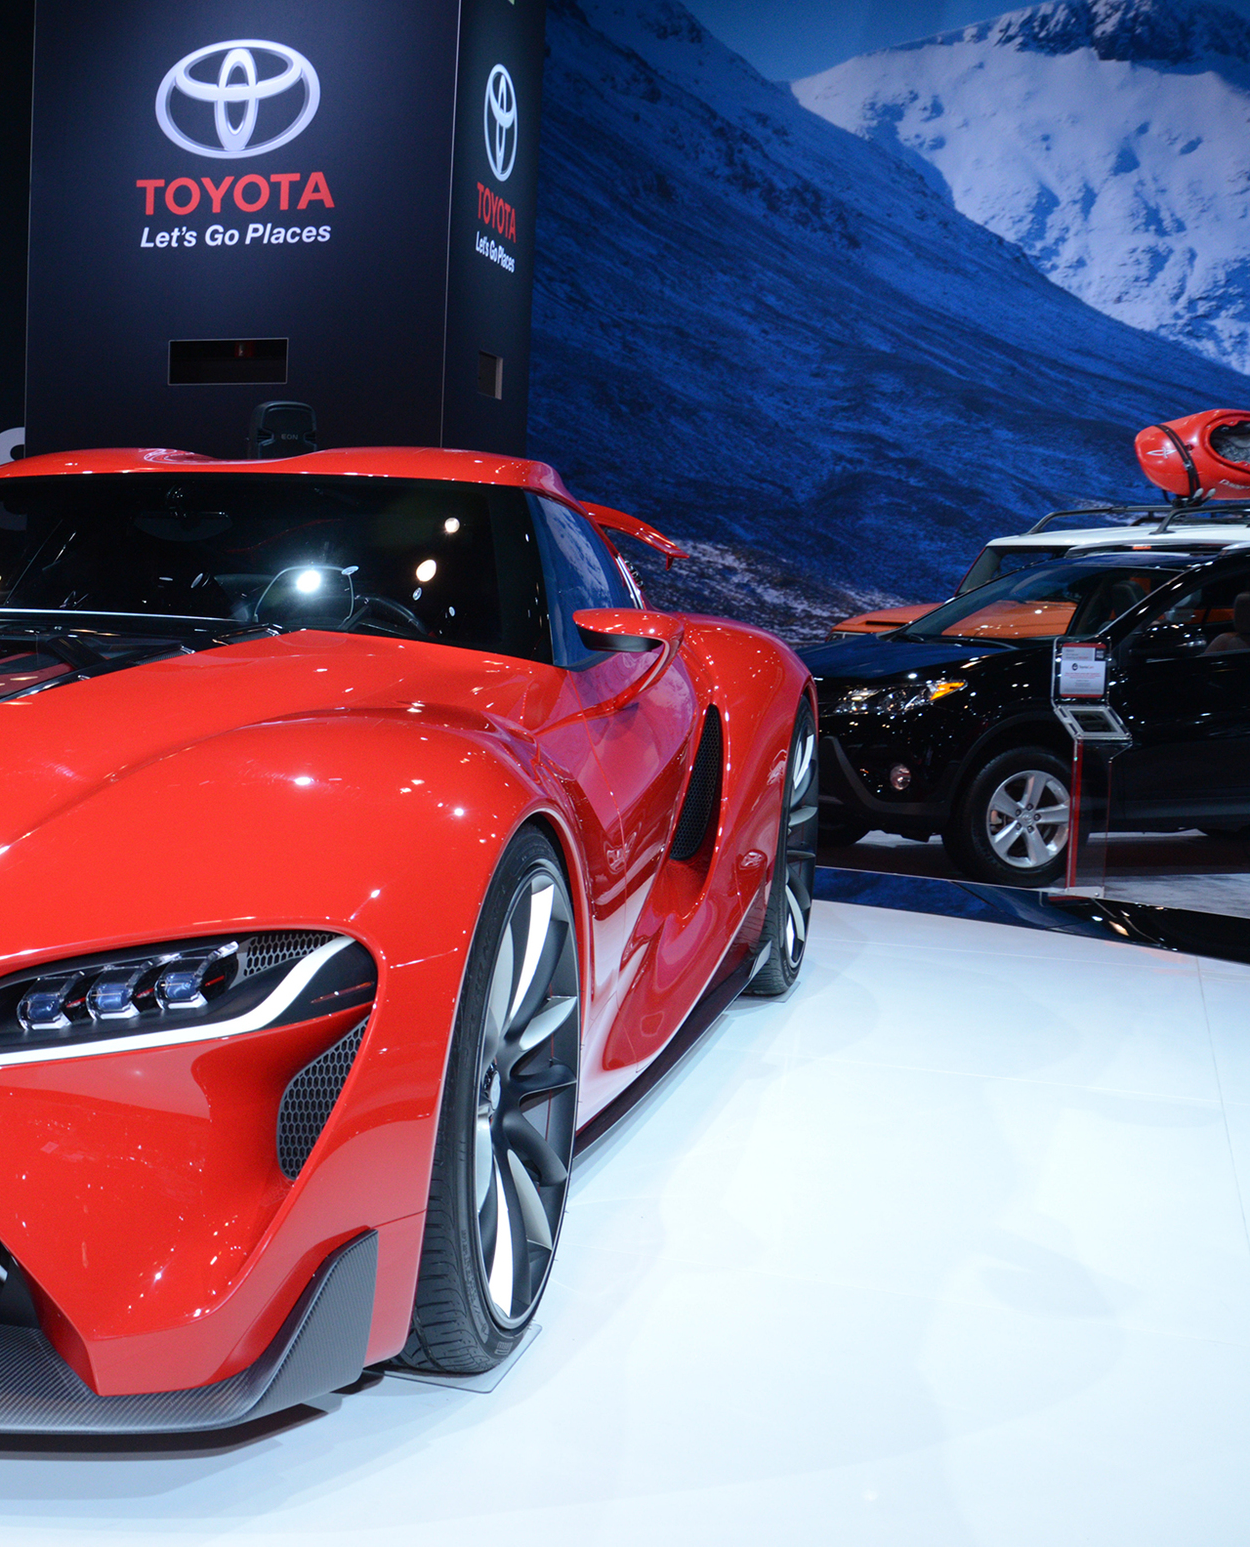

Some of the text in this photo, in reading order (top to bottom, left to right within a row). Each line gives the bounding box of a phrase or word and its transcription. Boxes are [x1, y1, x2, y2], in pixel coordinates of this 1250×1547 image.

[136, 171, 335, 216] TOYOTA
[476, 181, 517, 244] TOYOTA
[140, 222, 332, 248] Let's Go Places
[475, 231, 516, 273] Let's Go Places
